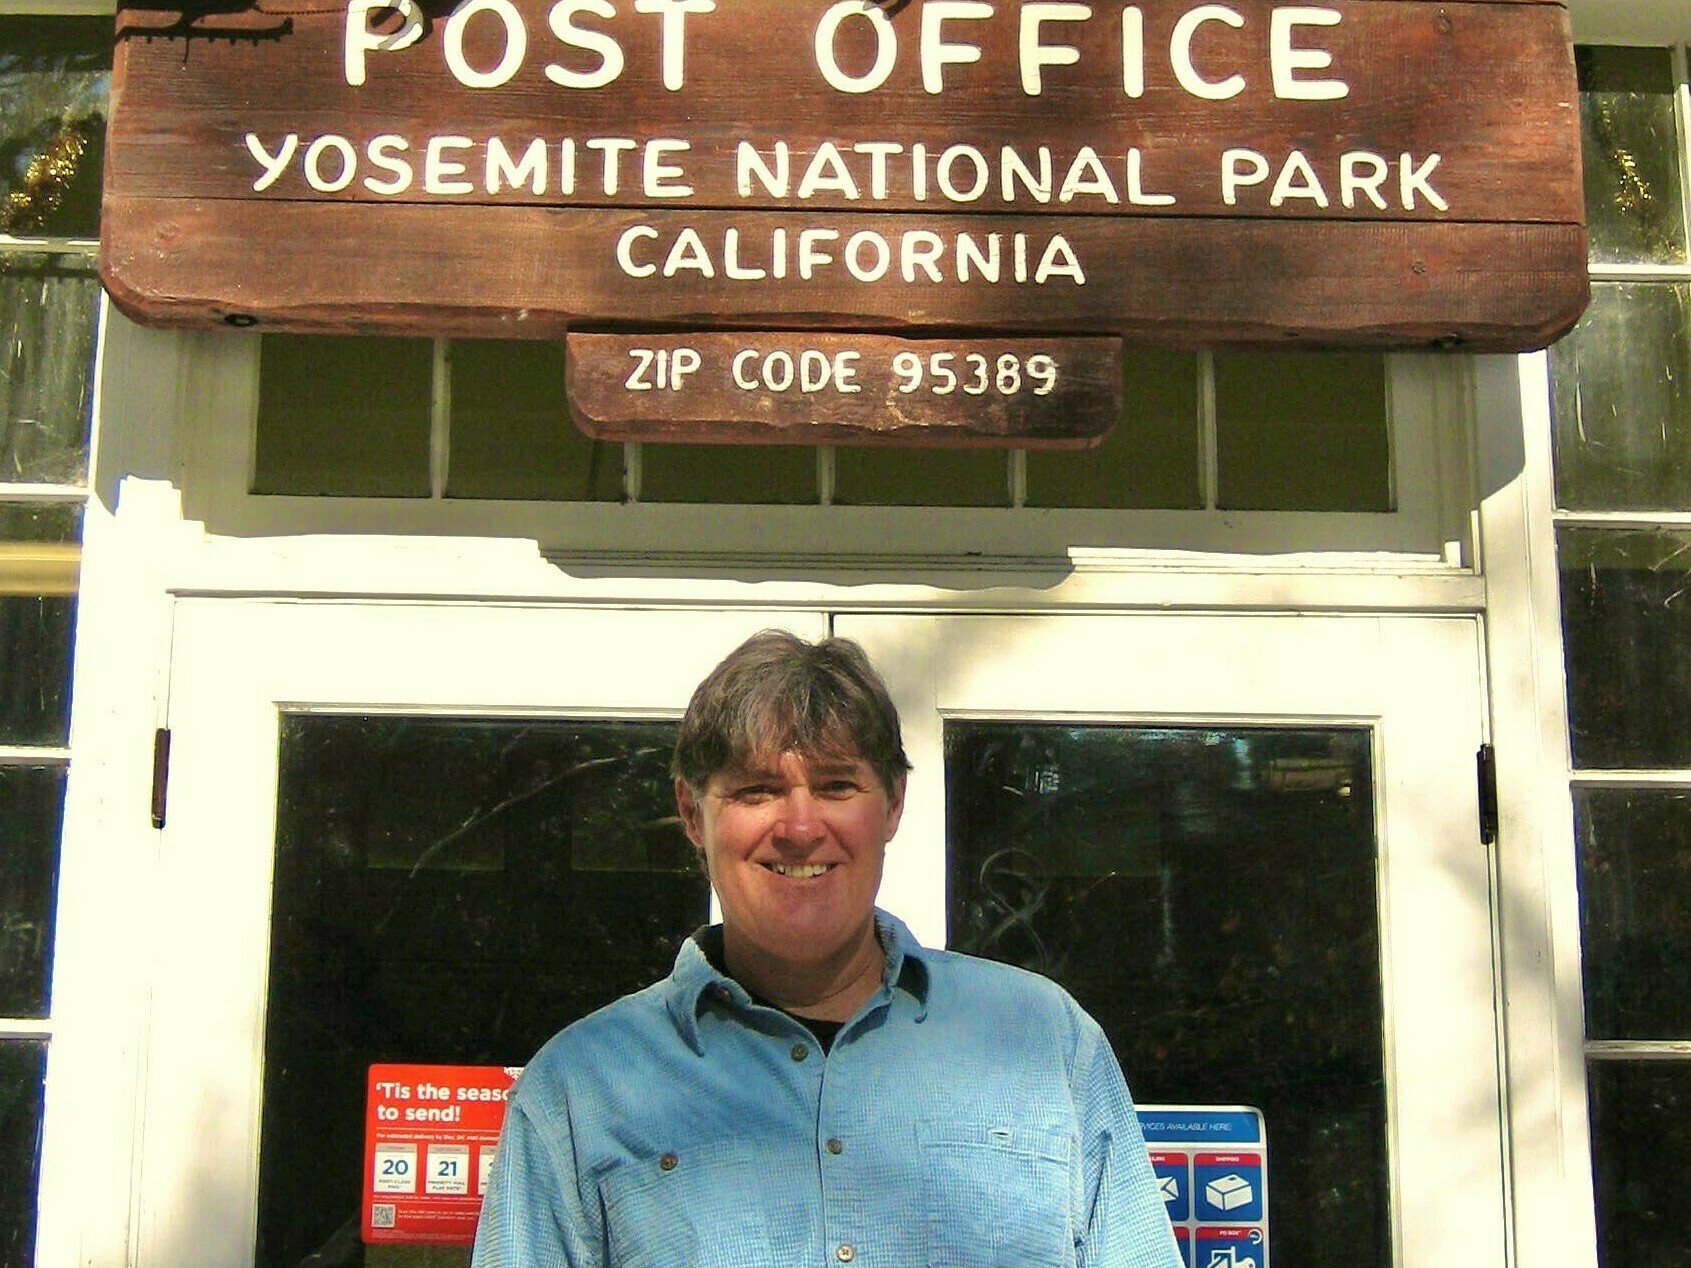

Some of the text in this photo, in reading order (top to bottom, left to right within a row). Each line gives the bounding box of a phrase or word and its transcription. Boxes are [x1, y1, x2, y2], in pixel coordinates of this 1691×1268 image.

[344, 0, 1349, 100] POST OFFICE
[245, 133, 1449, 212] YOSEMITE NATIONAL PARK
[616, 226, 1086, 286] CALIFORNIA
[624, 349, 1057, 397] ZIP CODE 95389
[417, 1083, 451, 1100] the
[377, 1105, 461, 1122] to send!
[382, 1159, 409, 1175] 20
[437, 1160, 458, 1177] 21
